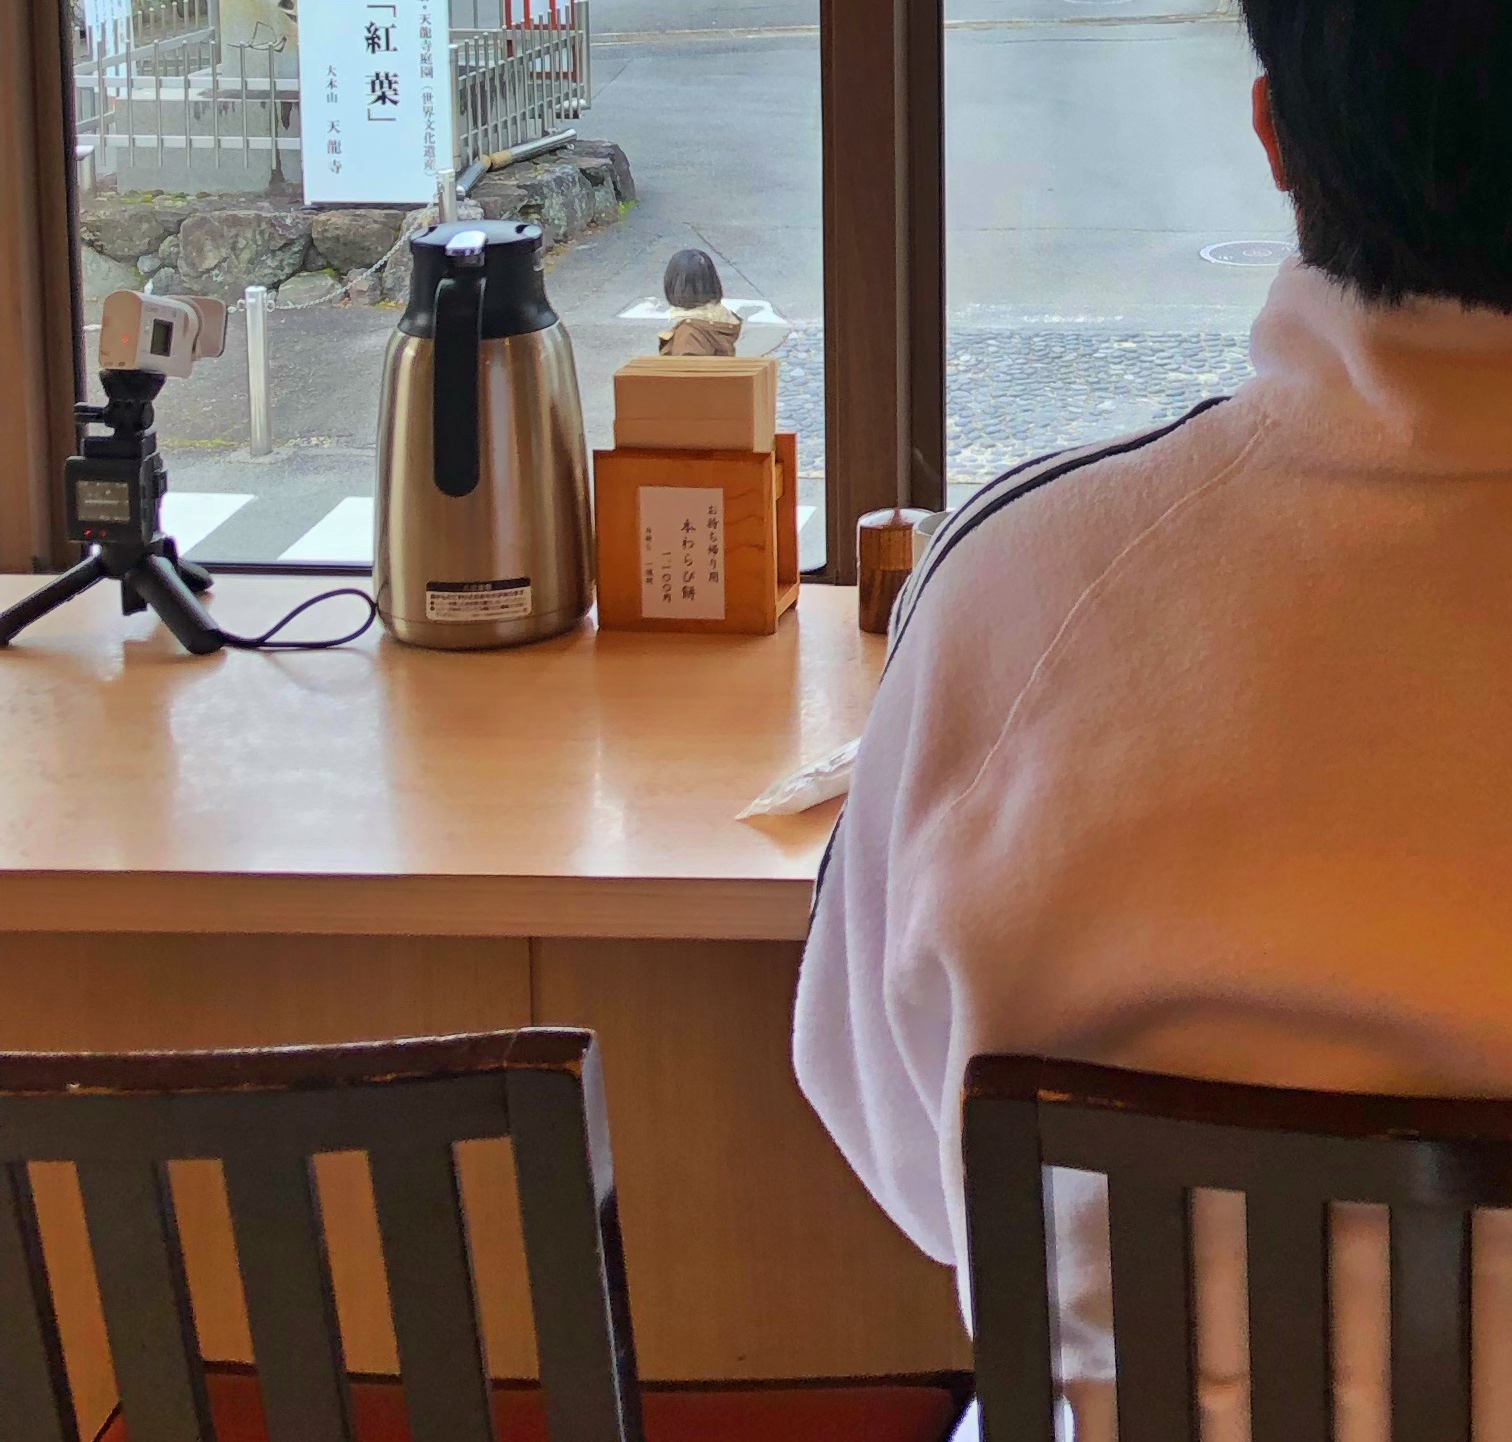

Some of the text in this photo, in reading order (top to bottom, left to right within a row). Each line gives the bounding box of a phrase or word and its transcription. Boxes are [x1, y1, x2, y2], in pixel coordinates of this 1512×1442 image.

[680, 518, 697, 601] 本わらび餅
